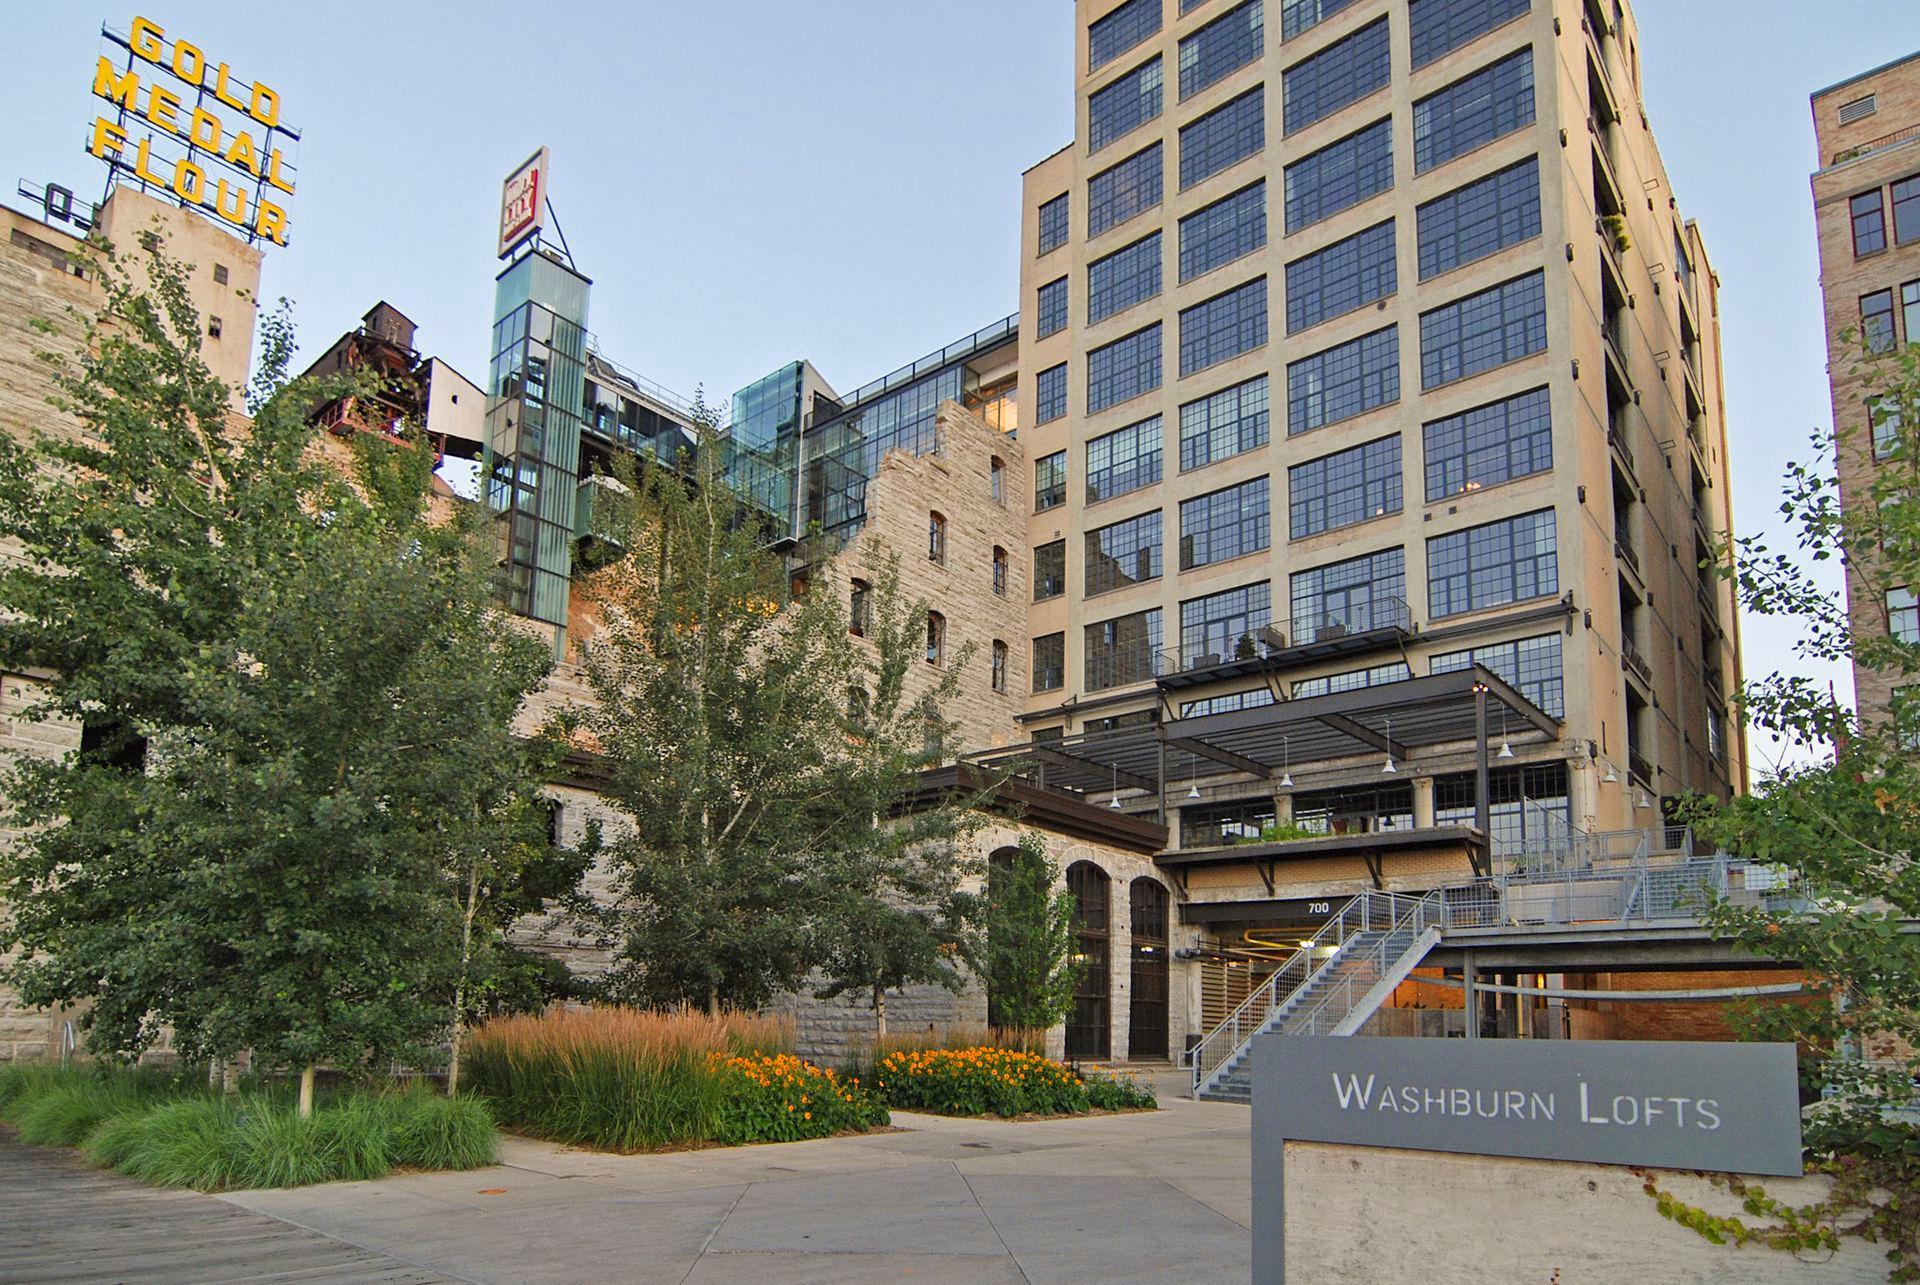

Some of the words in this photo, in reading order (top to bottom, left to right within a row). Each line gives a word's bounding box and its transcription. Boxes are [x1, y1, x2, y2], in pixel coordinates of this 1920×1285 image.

[93, 55, 295, 196] MEDAL
[130, 16, 280, 127] GOLD
[91, 116, 288, 247] FLOUR
[1309, 902, 1329, 914] 700
[1332, 1072, 1555, 1121] WASHBURN
[1579, 1081, 1722, 1130] LOFTS
